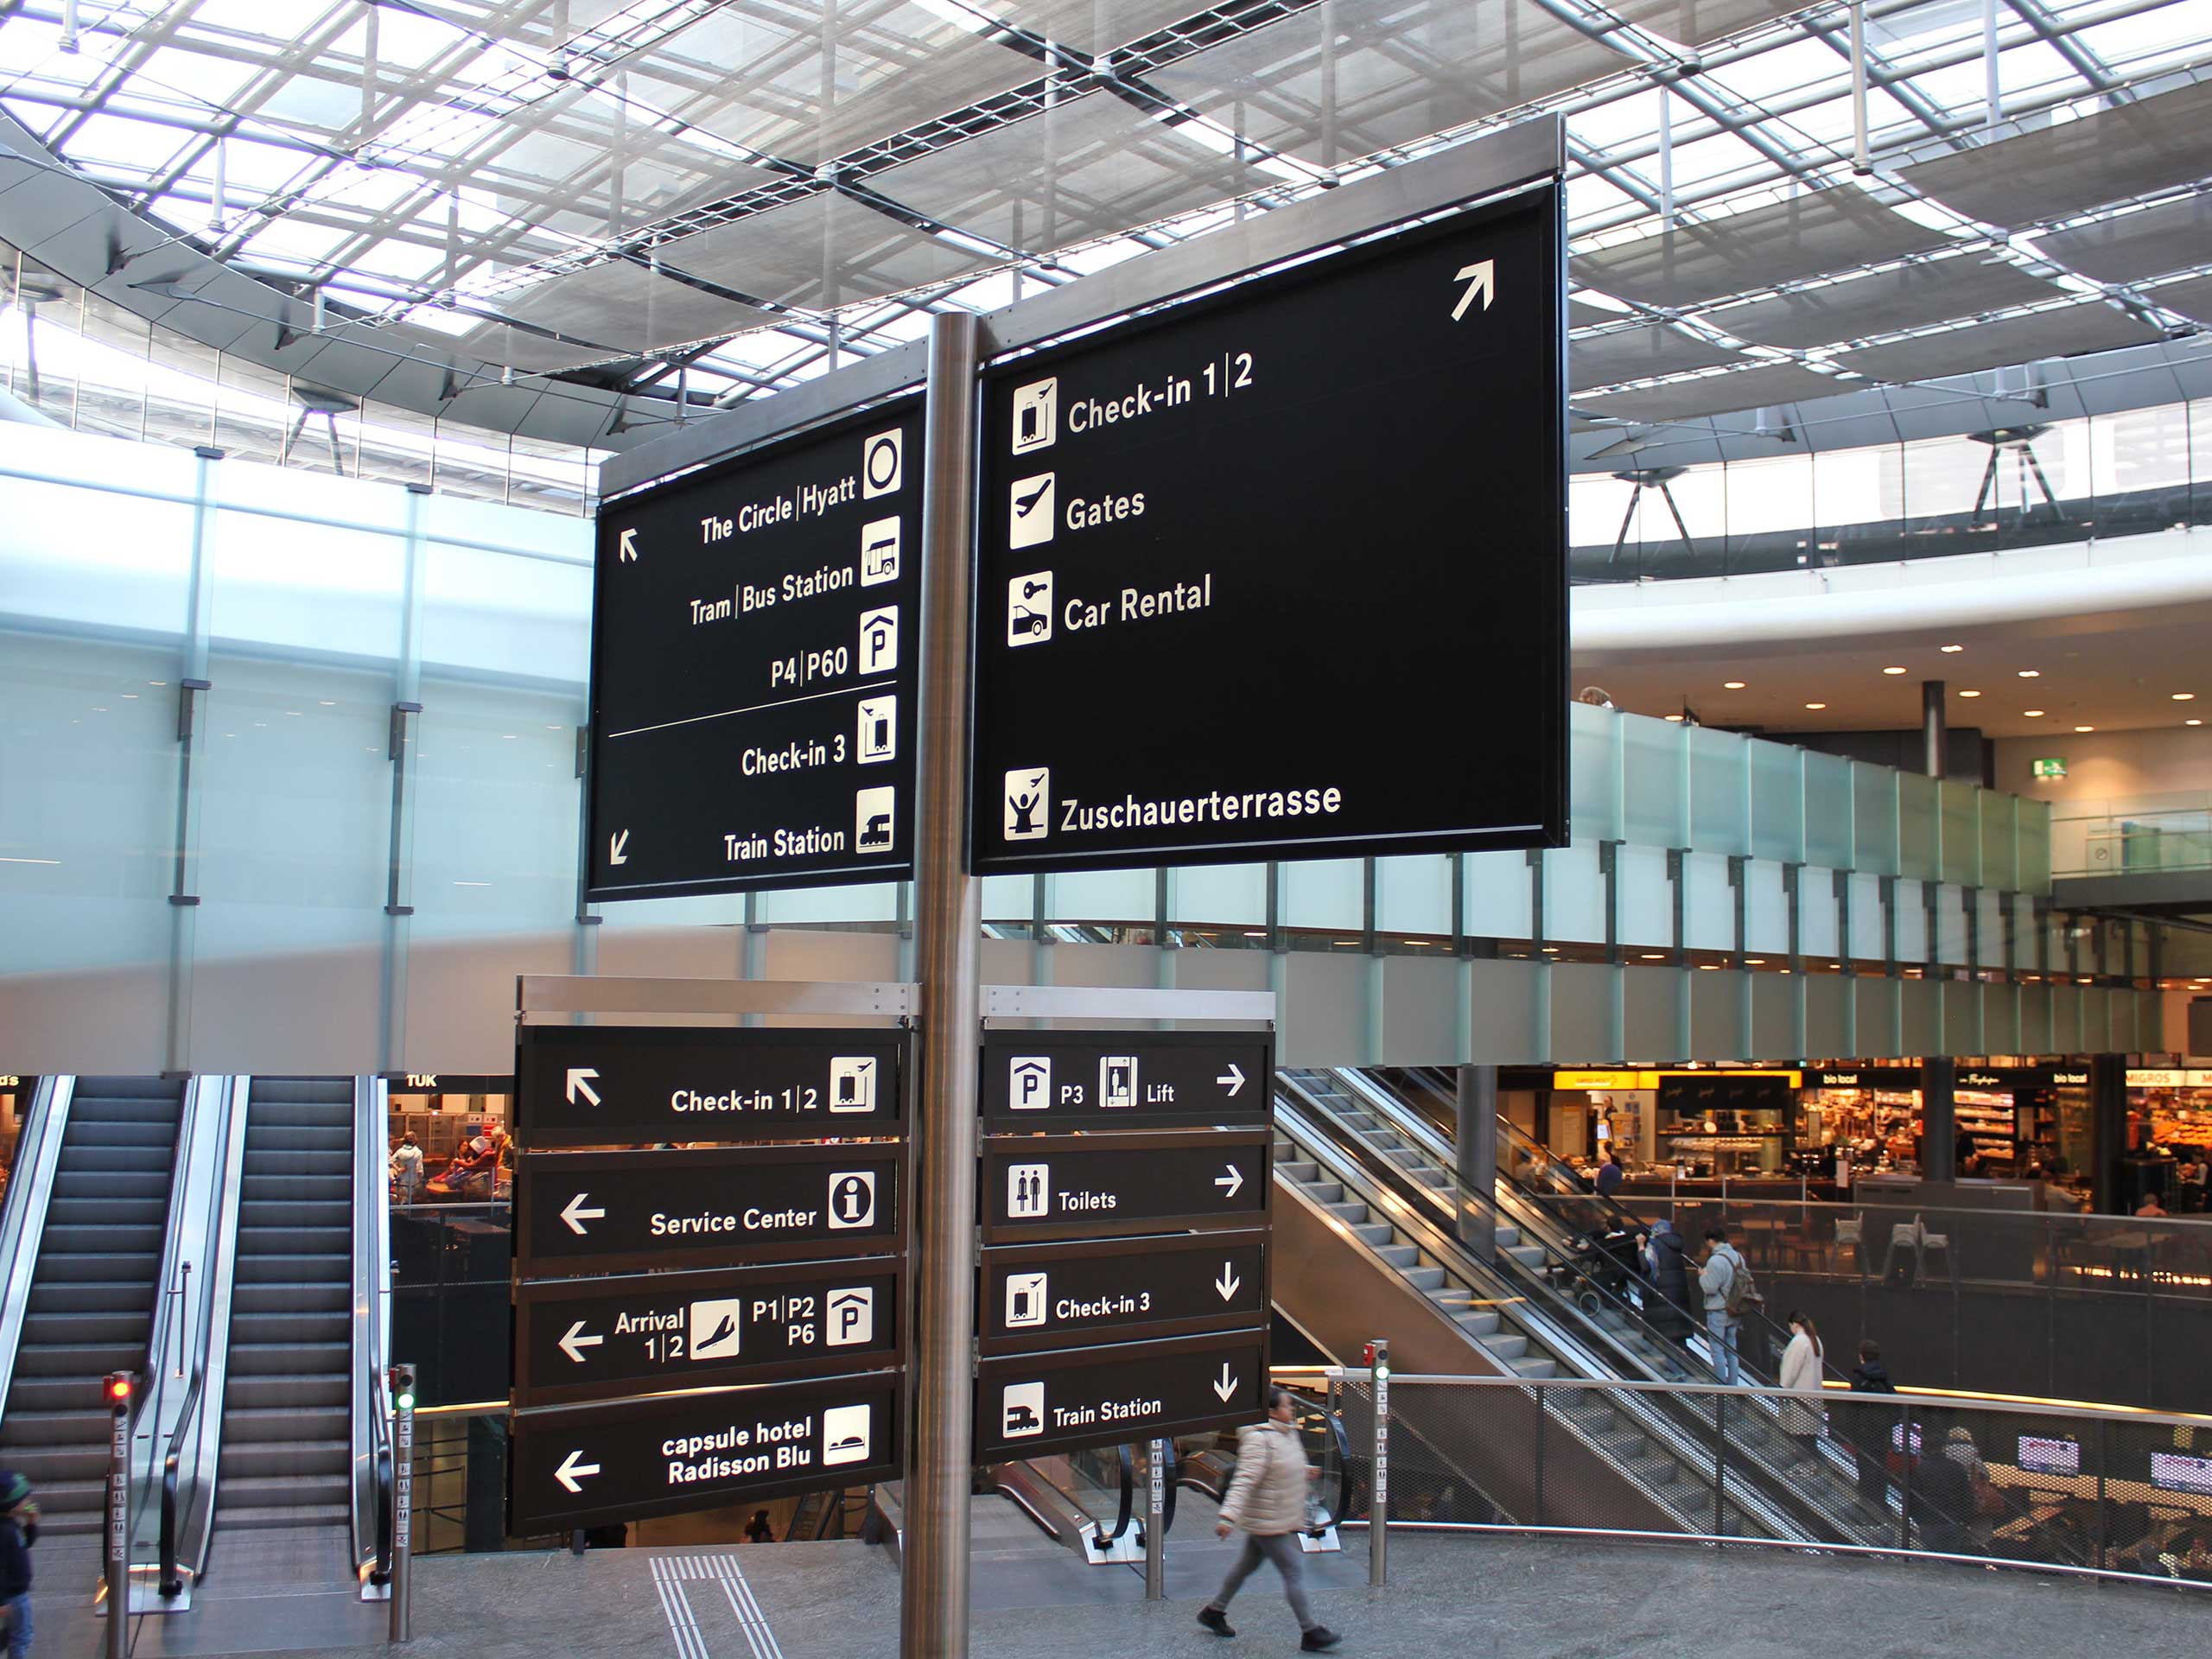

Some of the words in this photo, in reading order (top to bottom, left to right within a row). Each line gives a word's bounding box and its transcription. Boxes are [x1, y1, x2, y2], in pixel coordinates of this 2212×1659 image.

[1069, 376, 1190, 432] Check-in
[1067, 493, 1144, 530] Gates
[702, 517, 733, 543] The
[783, 566, 853, 601] Station
[1065, 599, 1110, 630] Car
[1122, 574, 1210, 620] Rental
[742, 740, 825, 775] Check-in
[834, 734, 845, 762] 3
[1061, 788, 1341, 830] Zuschauerterrasse
[724, 833, 767, 861] Train
[774, 826, 844, 856] Station
[1823, 1074, 1837, 1084] bio
[1837, 1074, 1857, 1084] local
[2053, 1073, 2067, 1084] bio
[2068, 1073, 2088, 1084] local
[671, 1090, 772, 1111] Check-in
[1062, 1085, 1083, 1103] P3
[1147, 1084, 1174, 1102] Lift
[1058, 1192, 1116, 1211] Toilets
[651, 1211, 735, 1235] Service
[744, 1209, 817, 1229] Center
[1057, 1295, 1134, 1319] Check-in
[1140, 1293, 1149, 1311] 3
[615, 1307, 683, 1334] Arrival
[789, 1324, 814, 1345] P6
[1053, 1406, 1095, 1427] Train
[1101, 1398, 1160, 1421] Station
[663, 1427, 749, 1458] capsule
[757, 1416, 810, 1443] hotel
[668, 1454, 770, 1484] Radisson
[777, 1446, 810, 1468] Blu
